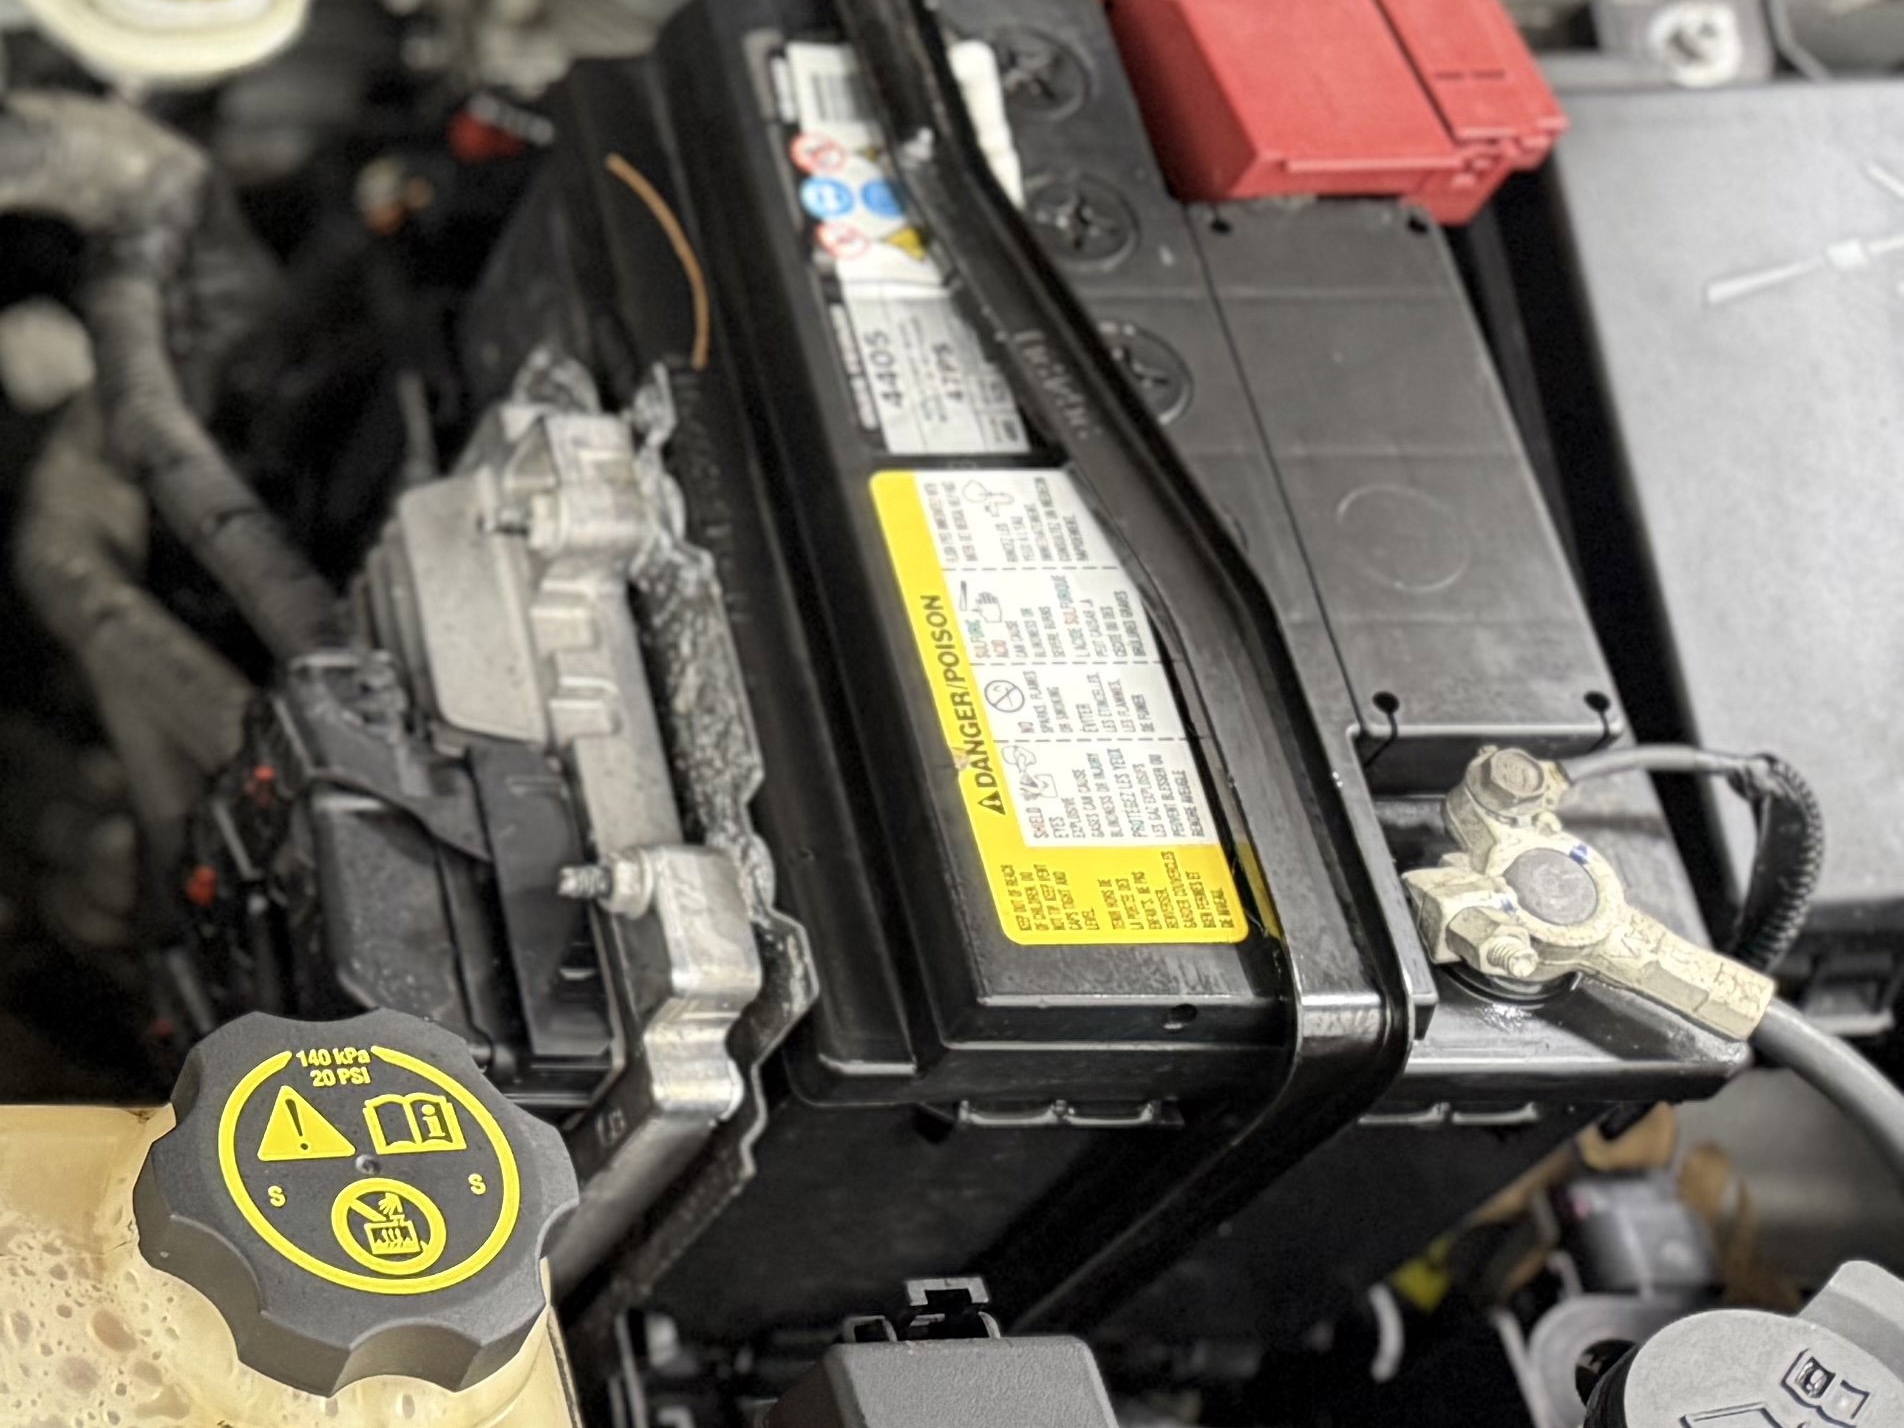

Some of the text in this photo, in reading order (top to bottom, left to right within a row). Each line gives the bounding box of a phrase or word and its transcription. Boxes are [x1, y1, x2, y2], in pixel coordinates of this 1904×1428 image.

[863, 330, 903, 406] 4405
[918, 594, 998, 787] DANGER/POISON
[1026, 807, 1048, 838] SHIELD
[1050, 816, 1067, 837] EYES
[296, 1047, 372, 1068] 140 kPa
[310, 1066, 372, 1087] 20 PSI
[467, 1173, 487, 1196] S
[267, 1185, 286, 1208] S
